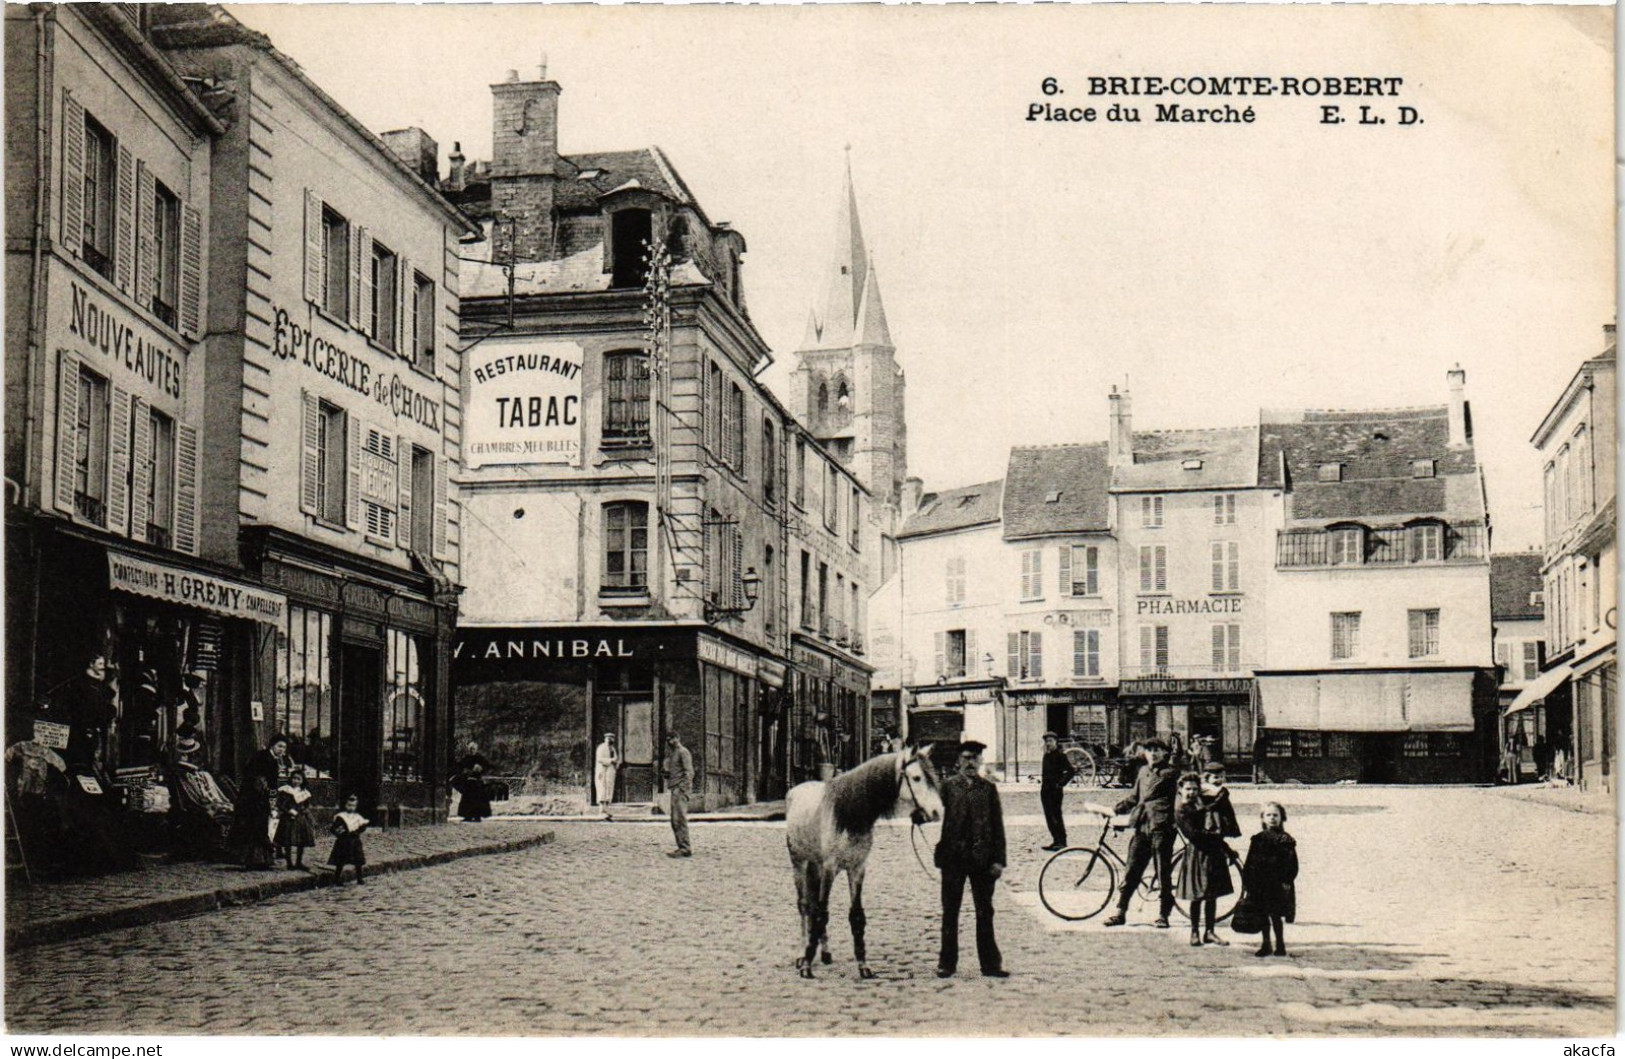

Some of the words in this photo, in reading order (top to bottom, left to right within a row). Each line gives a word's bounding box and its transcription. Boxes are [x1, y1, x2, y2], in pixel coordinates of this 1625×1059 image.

[69, 281, 181, 399] NOUVEAUTÉS
[474, 354, 581, 384] RESTAURANT
[373, 373, 389, 406] de
[390, 374, 440, 434] CHOIX
[495, 395, 578, 428] TABAC
[470, 441, 524, 454] CHAMBRES
[180, 575, 242, 610] GRÉMY
[246, 593, 282, 618] CHAPELLERIE
[1137, 599, 1242, 615] PHARMACIE
[484, 639, 634, 658] ANNIBAL
[1121, 679, 1187, 693] PHARMACIE
[1195, 679, 1250, 692] BERNARD
